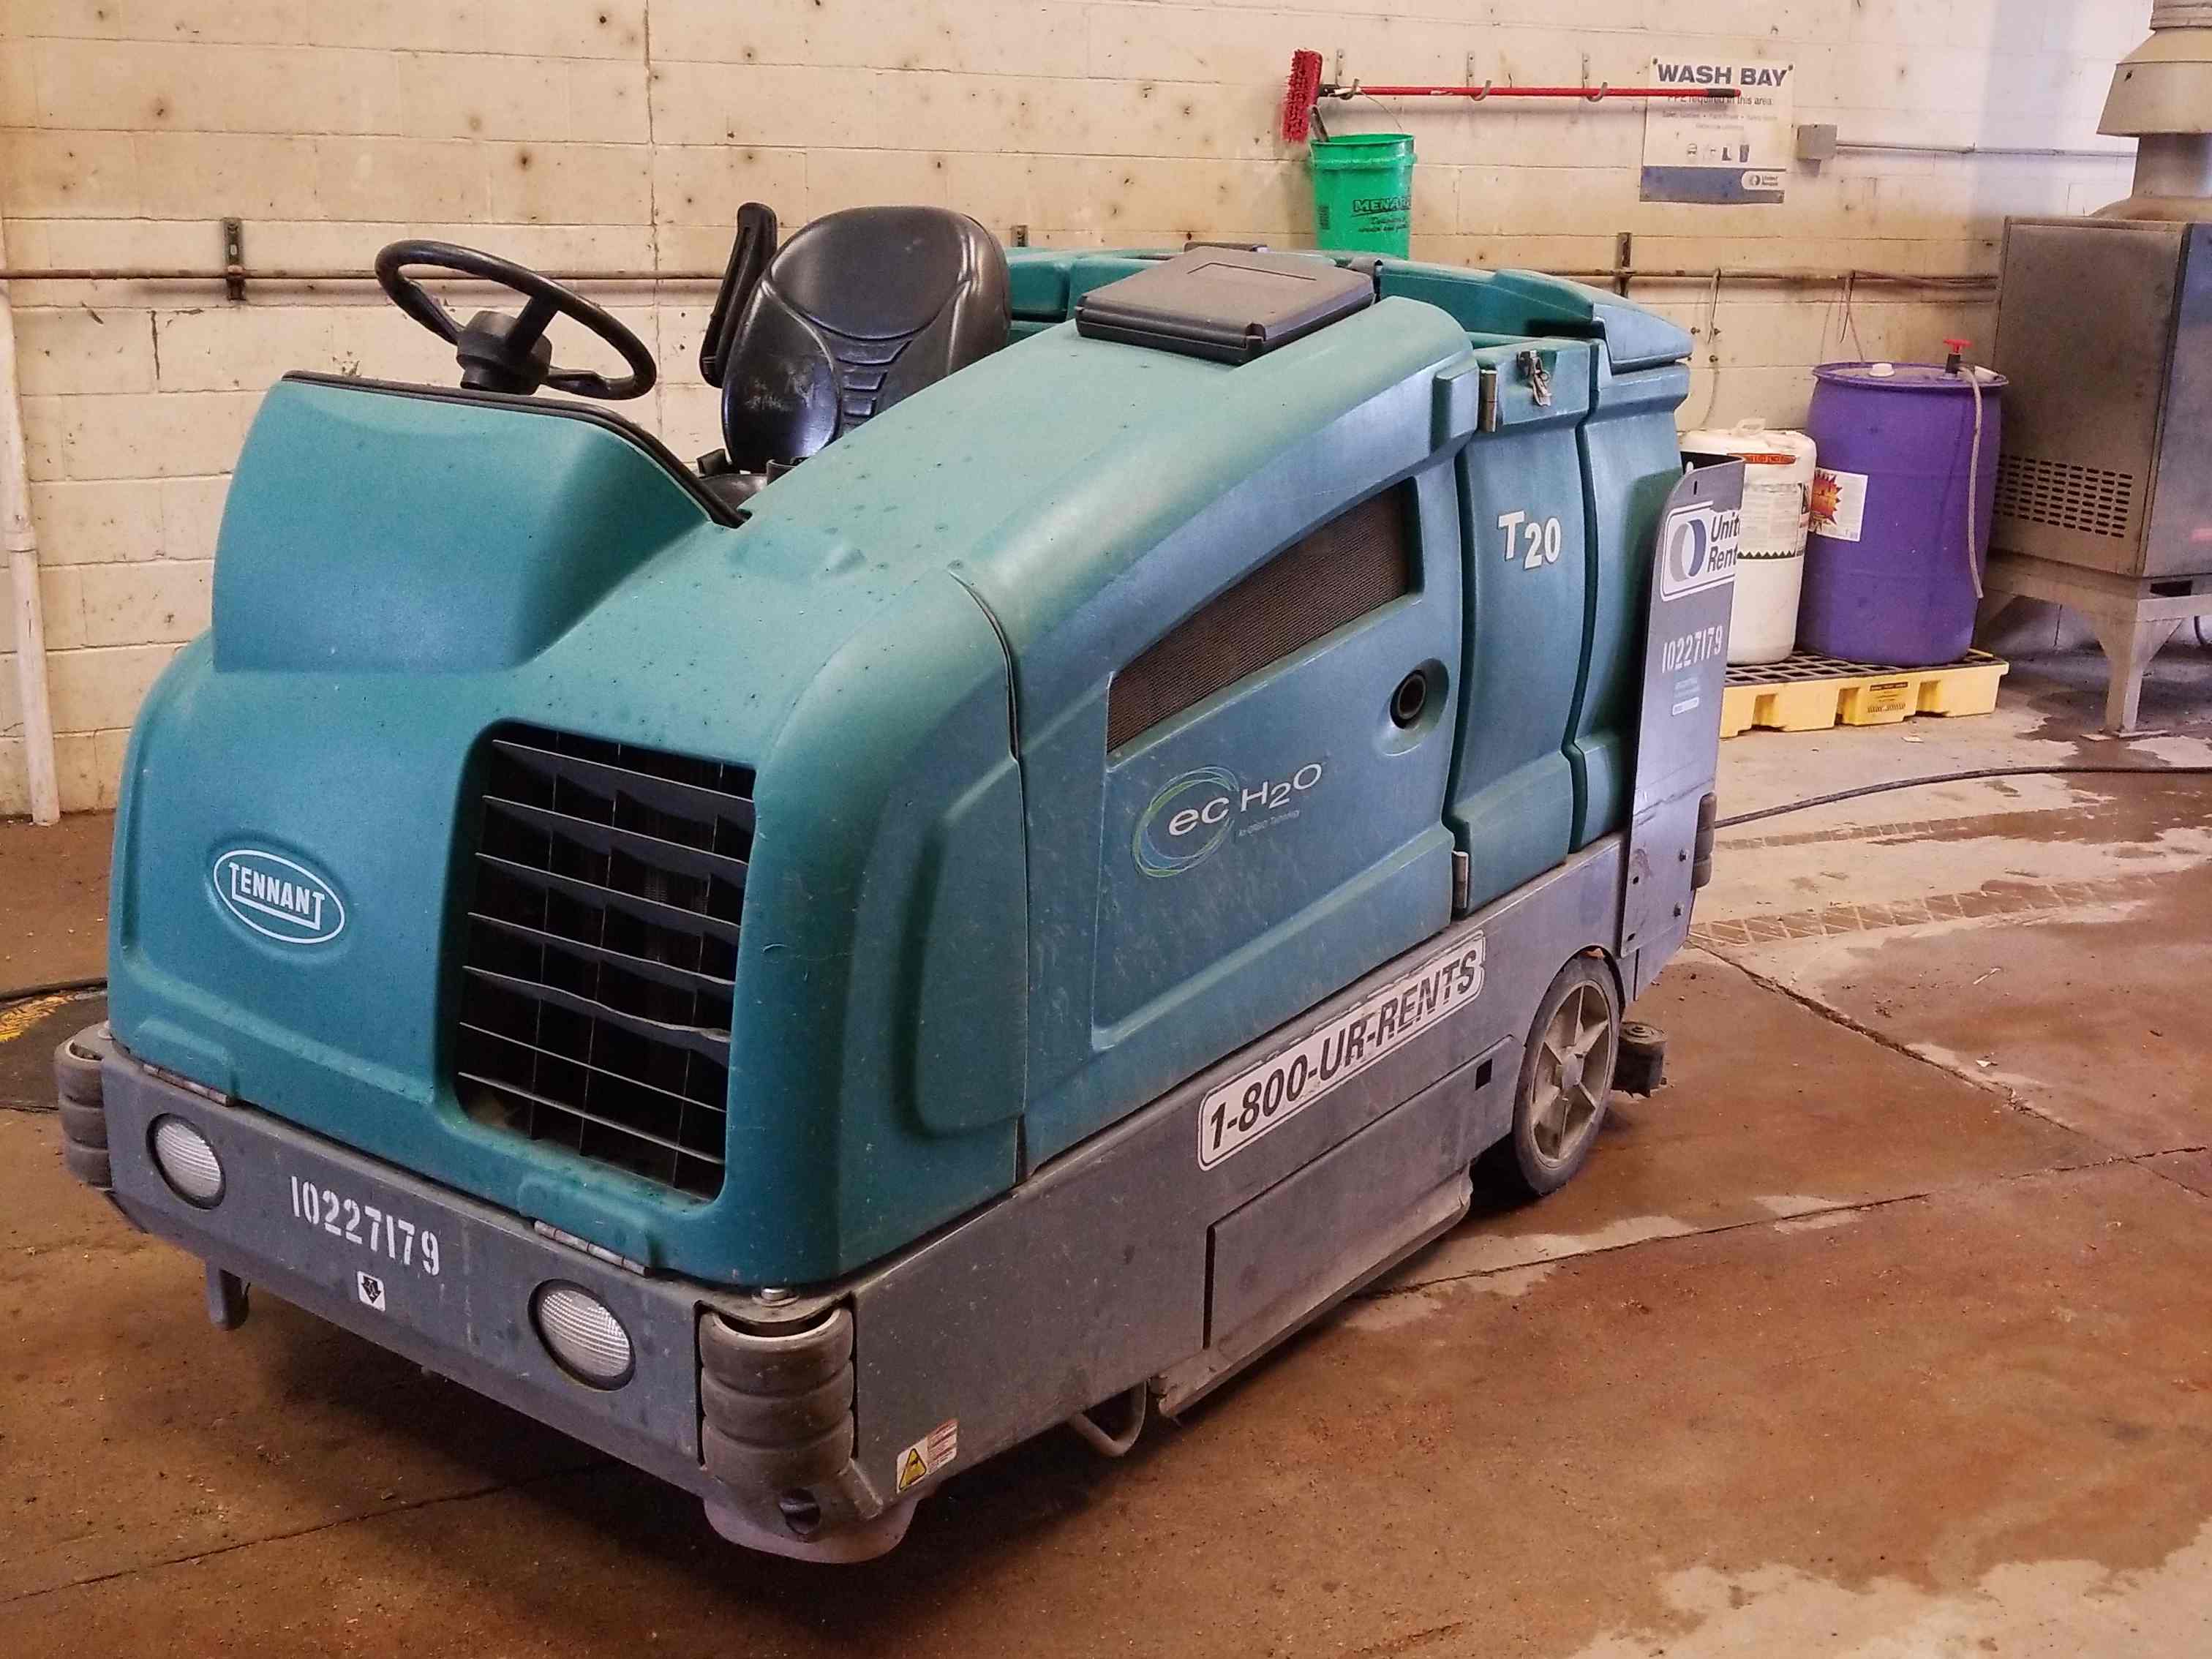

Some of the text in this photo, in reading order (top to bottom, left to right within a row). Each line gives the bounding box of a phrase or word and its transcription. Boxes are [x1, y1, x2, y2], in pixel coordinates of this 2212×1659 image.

[1658, 64, 1788, 87] WASH BAY
[1737, 95, 1752, 105] this
[1498, 510, 1561, 570] T20
[1710, 511, 1741, 543] Unit
[1662, 625, 1723, 674] 10227179
[228, 861, 326, 931] TENNANT
[1210, 949, 1477, 1151] 1-800-UR-RENTS
[291, 1175, 440, 1276] 10227179
